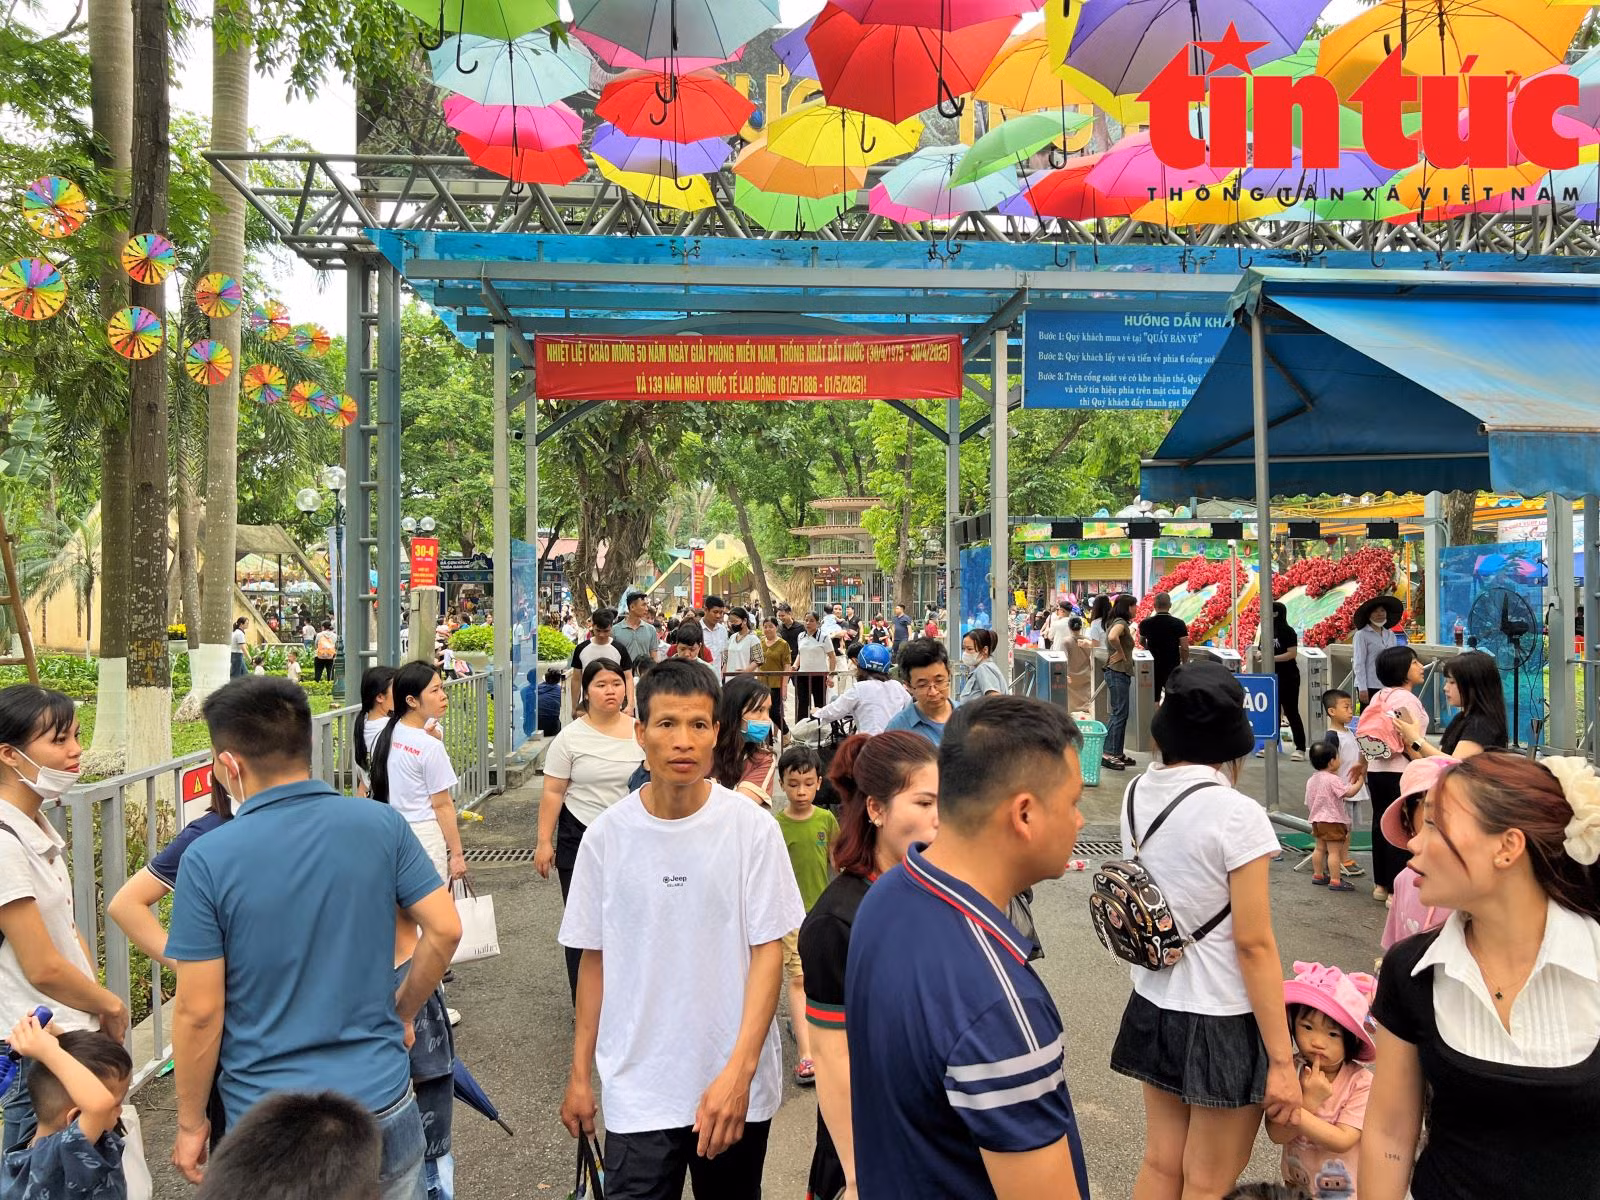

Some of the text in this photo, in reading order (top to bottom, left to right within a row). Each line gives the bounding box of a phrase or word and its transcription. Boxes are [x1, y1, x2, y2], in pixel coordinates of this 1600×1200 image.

[1124, 313, 1170, 327] HƯỚNG
[1173, 312, 1201, 327] DẪN
[1058, 332, 1065, 340] 1:
[1065, 332, 1081, 342] Quý
[1082, 332, 1104, 342] khách
[546, 341, 569, 366] NHIỆT
[571, 341, 587, 366] LIỆT
[588, 341, 610, 363] CHÀO
[611, 340, 635, 363] MỪNG
[636, 344, 647, 363] 50
[649, 341, 667, 363] NĂM
[668, 341, 690, 363] NGÀY
[690, 339, 706, 363] GIẢI
[708, 341, 733, 363] PHÓNG
[735, 339, 756, 363] MIỀN
[757, 344, 778, 365] NAM,
[780, 339, 804, 363] THỐNG
[806, 339, 825, 363] NHẤT
[827, 339, 842, 363] ĐẤT
[843, 341, 865, 363] NƯỚC
[1057, 352, 1064, 361] 2:
[1065, 352, 1080, 363] Quý
[1081, 352, 1104, 362] khách
[1057, 372, 1064, 381] 3:
[1064, 372, 1083, 381] Trên
[635, 372, 647, 394] VÀ
[648, 375, 663, 394] 139
[664, 373, 682, 394] NĂM
[684, 372, 706, 394] NGÀY
[706, 370, 727, 396] QUỐC
[728, 370, 738, 394] TẾ
[739, 375, 754, 394] LAO
[755, 372, 776, 397] ĐỘNG
[778, 375, 818, 395] (01/5/1886
[1107, 397, 1130, 407] khách
[1145, 398, 1167, 407] thanh
[414, 544, 435, 558] 30-4
[1243, 686, 1268, 713] ÀO
[403, 745, 421, 757] NAM
[670, 874, 688, 883] Jeep
